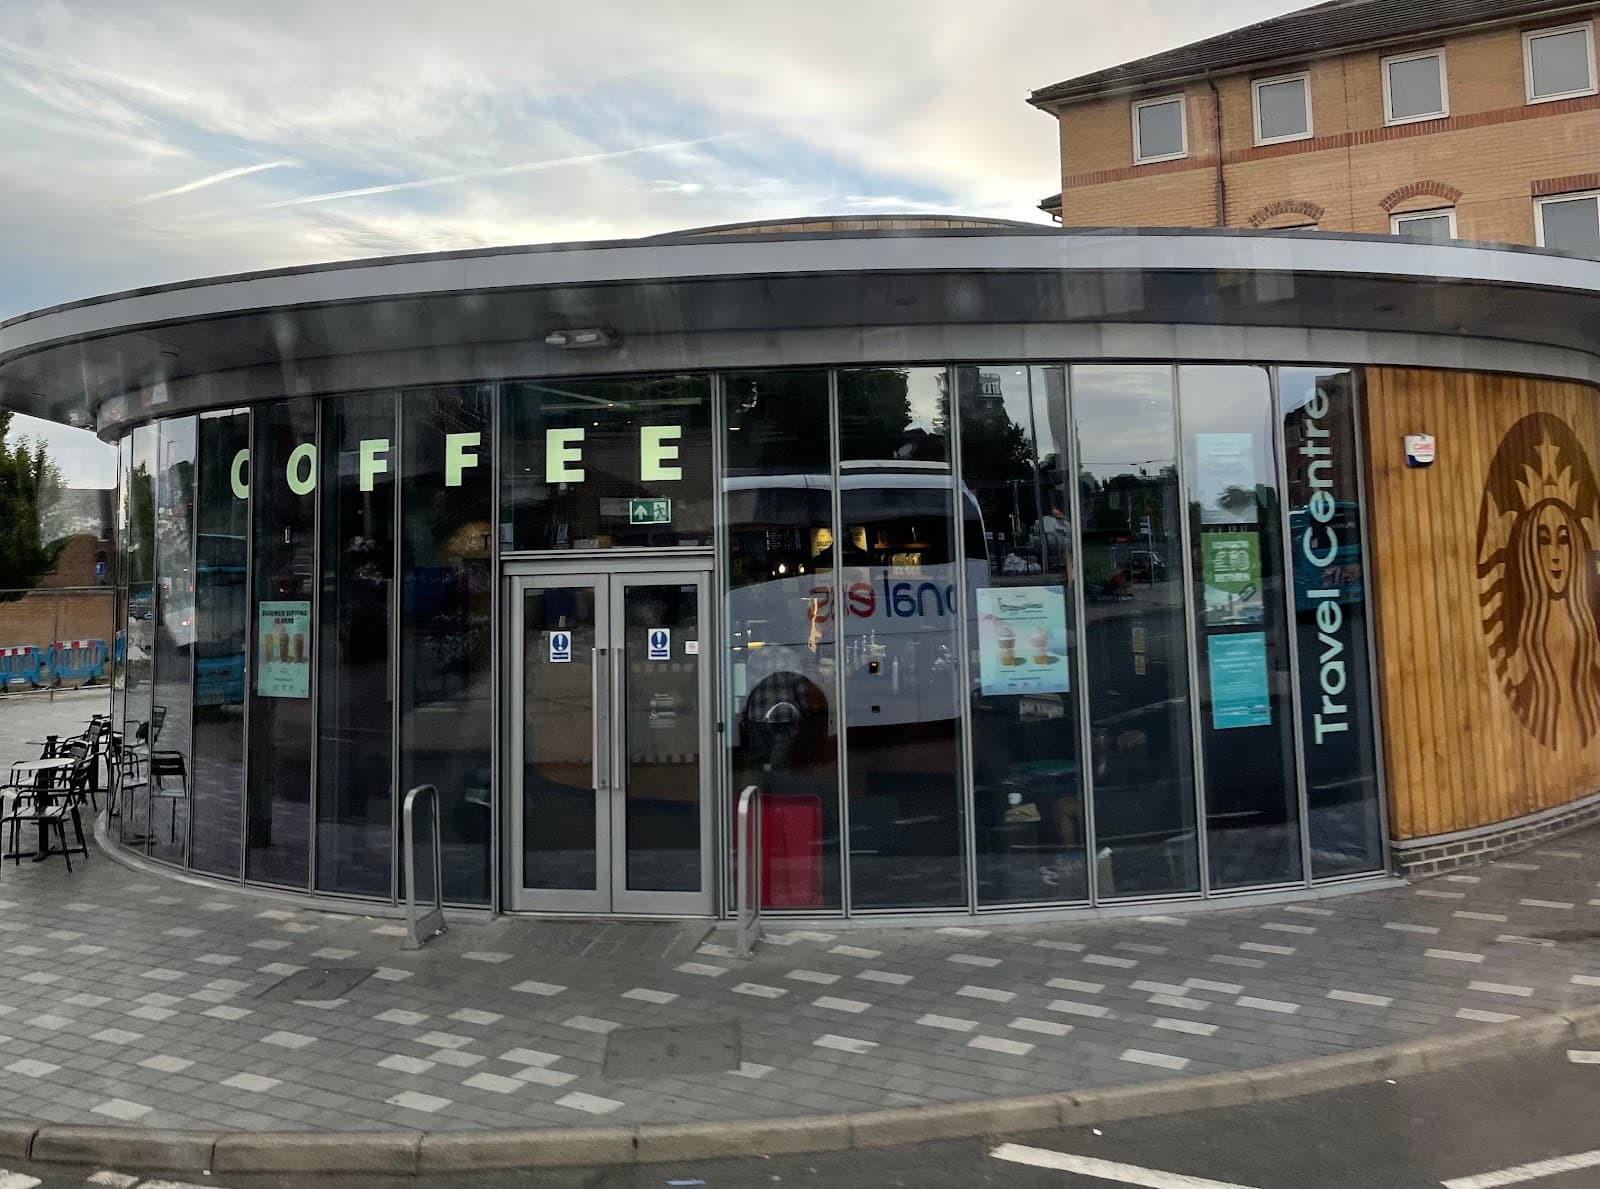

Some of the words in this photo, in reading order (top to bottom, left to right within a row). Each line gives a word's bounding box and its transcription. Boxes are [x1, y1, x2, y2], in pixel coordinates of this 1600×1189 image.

[230, 425, 682, 499] COFFEE
[1299, 387, 1339, 567] Centre
[1306, 588, 1350, 745] Travel
